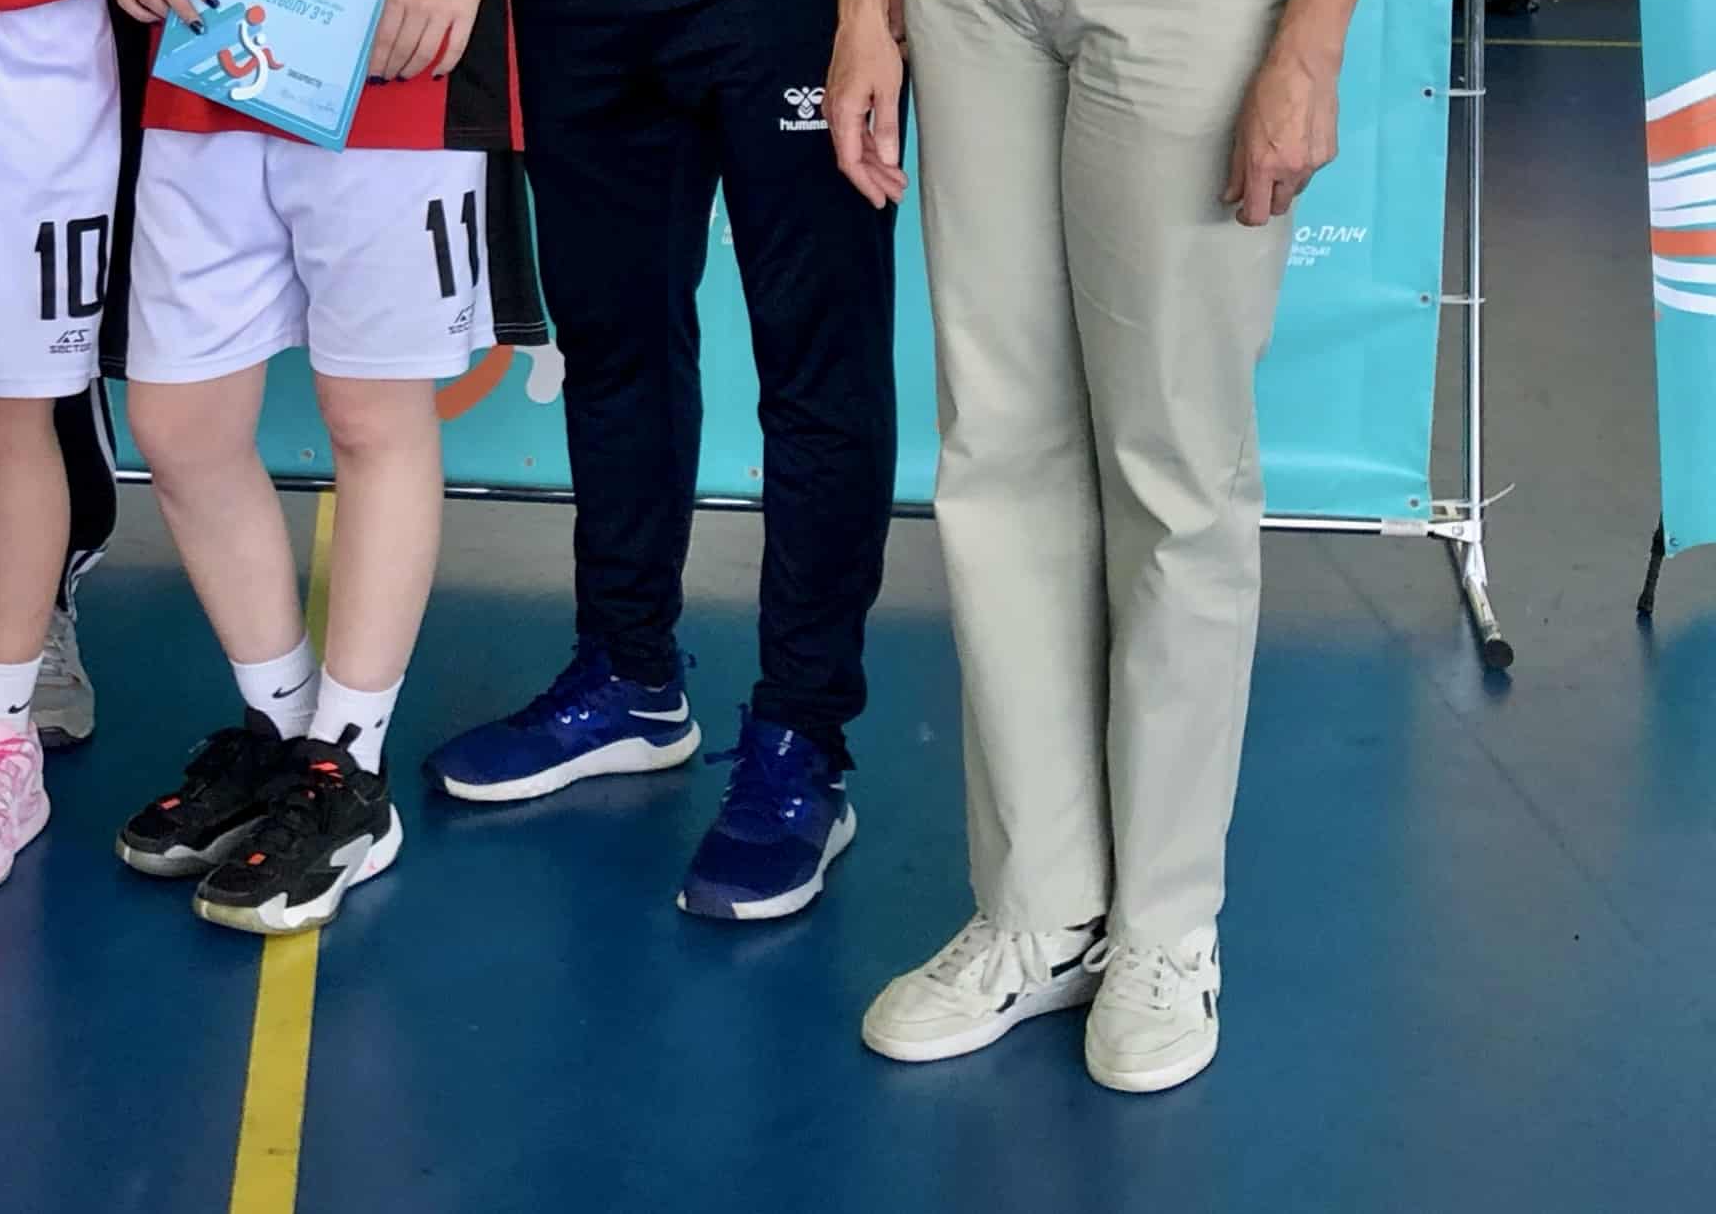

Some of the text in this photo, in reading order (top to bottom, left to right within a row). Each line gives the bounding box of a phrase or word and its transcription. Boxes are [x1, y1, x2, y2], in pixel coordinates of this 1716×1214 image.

[780, 117, 829, 131] humme
[425, 190, 480, 299] 11
[1294, 225, 1368, 243] О-ПЛІЧ
[34, 214, 109, 321] 10
